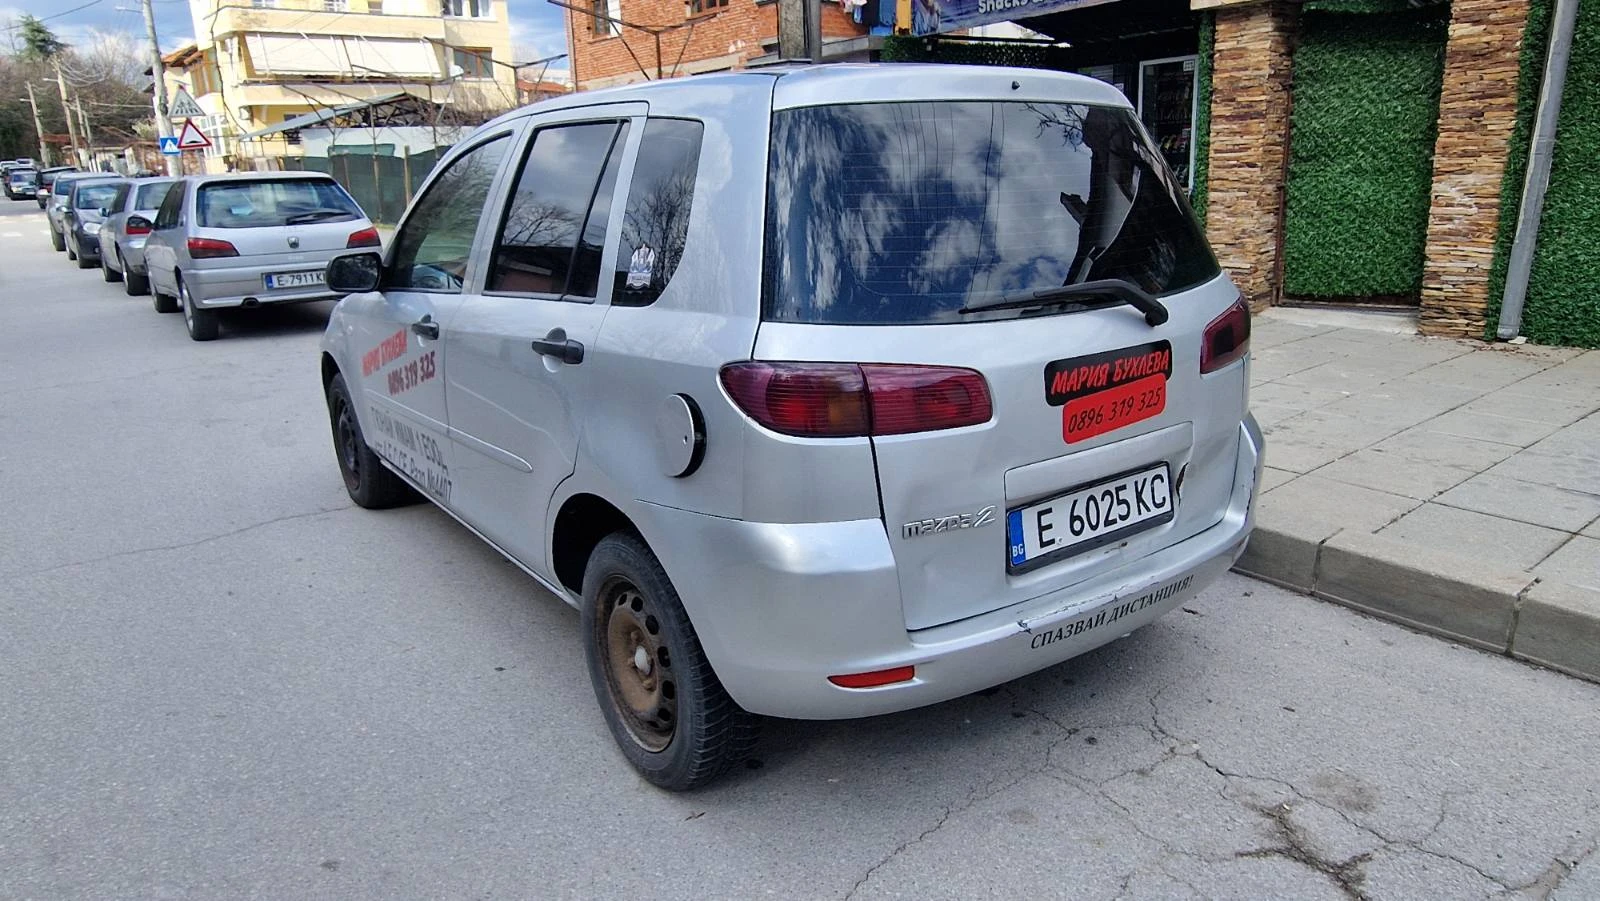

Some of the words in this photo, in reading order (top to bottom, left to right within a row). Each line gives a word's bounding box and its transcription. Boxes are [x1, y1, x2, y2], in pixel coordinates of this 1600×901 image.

[404, 360, 417, 389] 319
[420, 350, 436, 382] 325
[1050, 363, 1110, 395] МАРИЯ
[1112, 349, 1169, 382] БУХЛЕВА
[1068, 405, 1103, 434] 0896
[1108, 396, 1135, 421] 319
[1138, 387, 1162, 412] 325
[1037, 507, 1056, 548] E
[1012, 543, 1024, 557] BG
[1031, 609, 1106, 649] СПАЗВАЙ
[1106, 574, 1194, 627] ДИСТАНЦИЯ!
